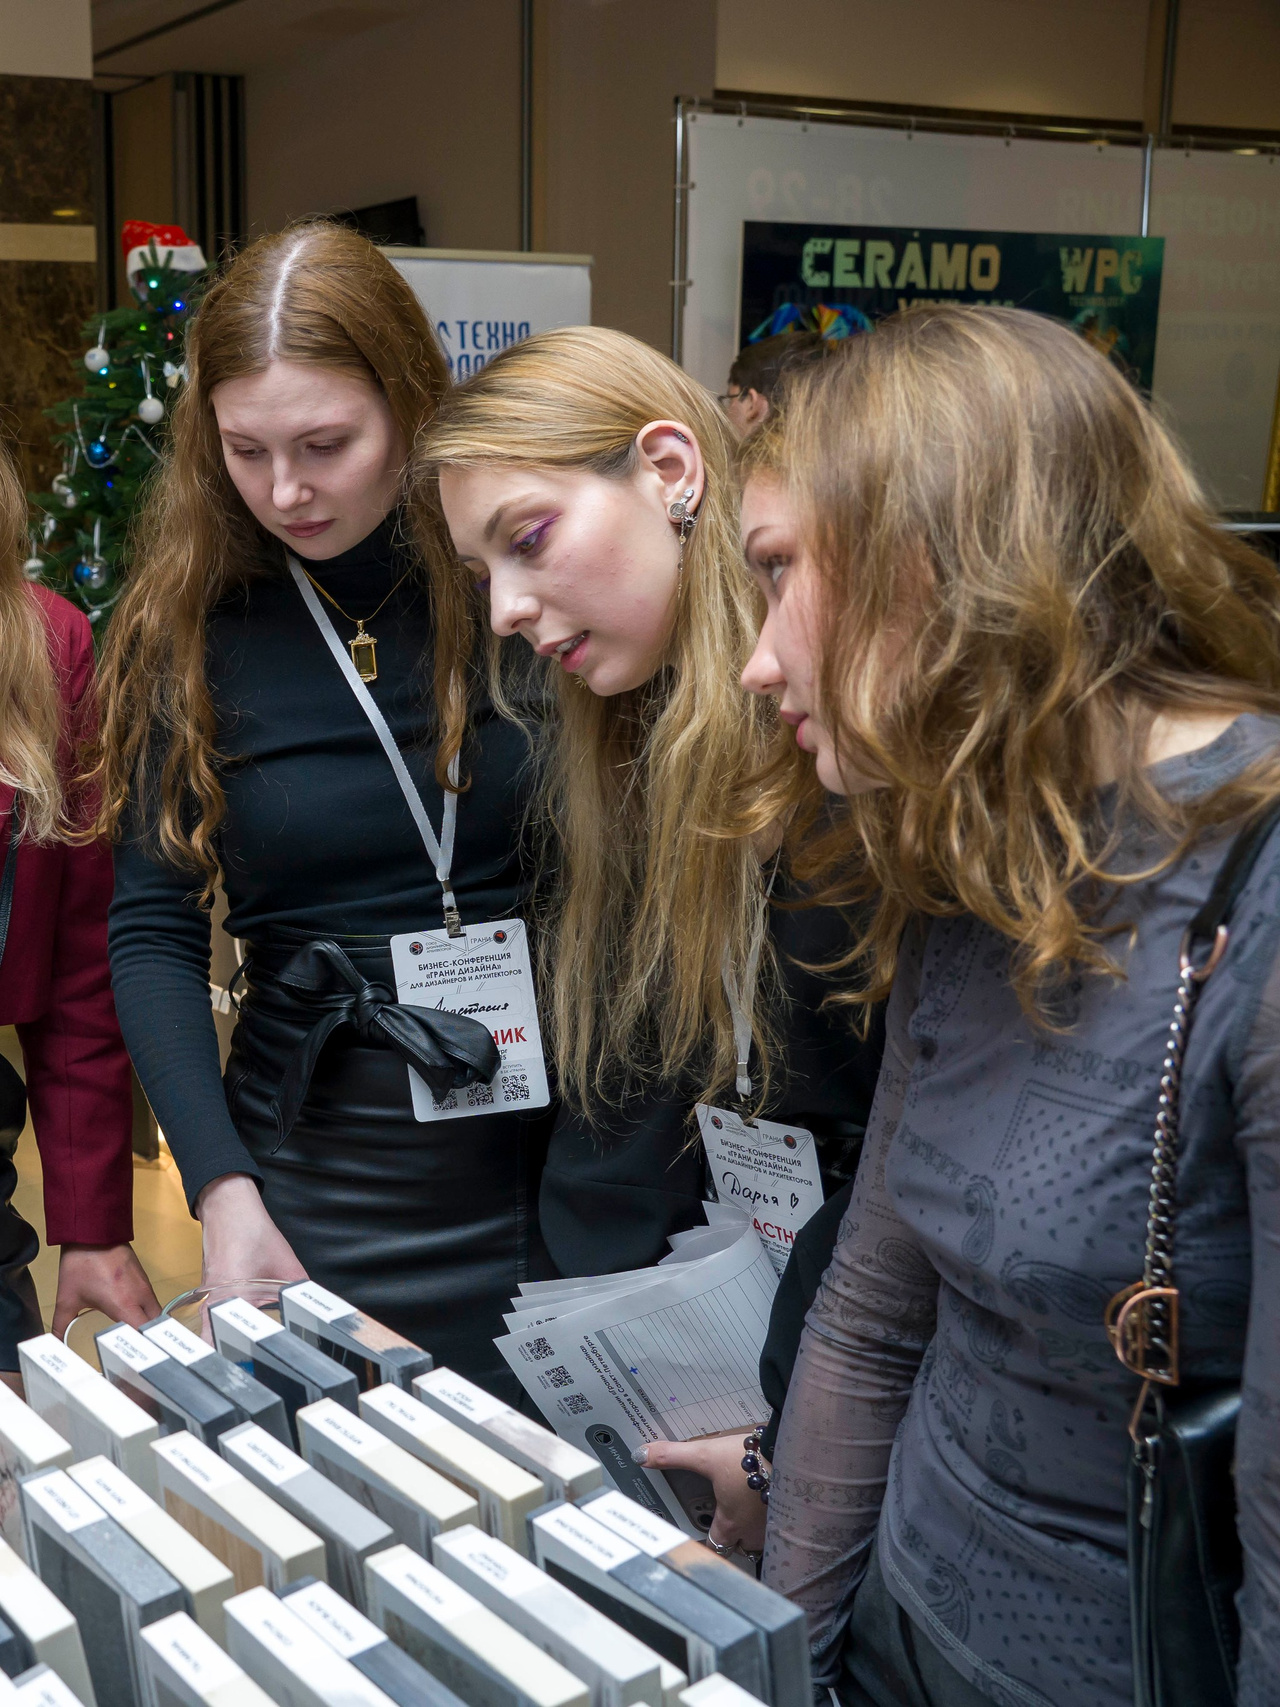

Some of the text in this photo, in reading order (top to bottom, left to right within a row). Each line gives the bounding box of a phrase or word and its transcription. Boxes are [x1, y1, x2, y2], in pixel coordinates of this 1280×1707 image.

[1059, 246, 1142, 294] WPC
[418, 952, 511, 971] БИЗНЕС-КОНФЕРЕНЦИЯ
[426, 964, 501, 979] «ГРАНИ ДИЗАЙНА»
[424, 977, 467, 988] ДИЗАЙНЕРОВ
[474, 969, 522, 980] АРХИТЕКТОРОВ
[720, 1139, 802, 1168] БИЗНЕС-КОНФЕРЕНЦИЯ
[754, 1157, 793, 1174] ДИЗАЙНА»
[727, 1157, 762, 1173] ДИЗАЙНЕРОВ
[768, 1170, 813, 1186] АРХИТЕКТОРОВ
[722, 1171, 779, 1206] Дарья
[583, 1335, 625, 1393] Санкт-Петербурге
[638, 1389, 656, 1413] Отметка
[738, 1401, 752, 1418] дилер
[627, 1397, 658, 1440] архитекторов
[608, 1446, 627, 1469] ГРАНИ
